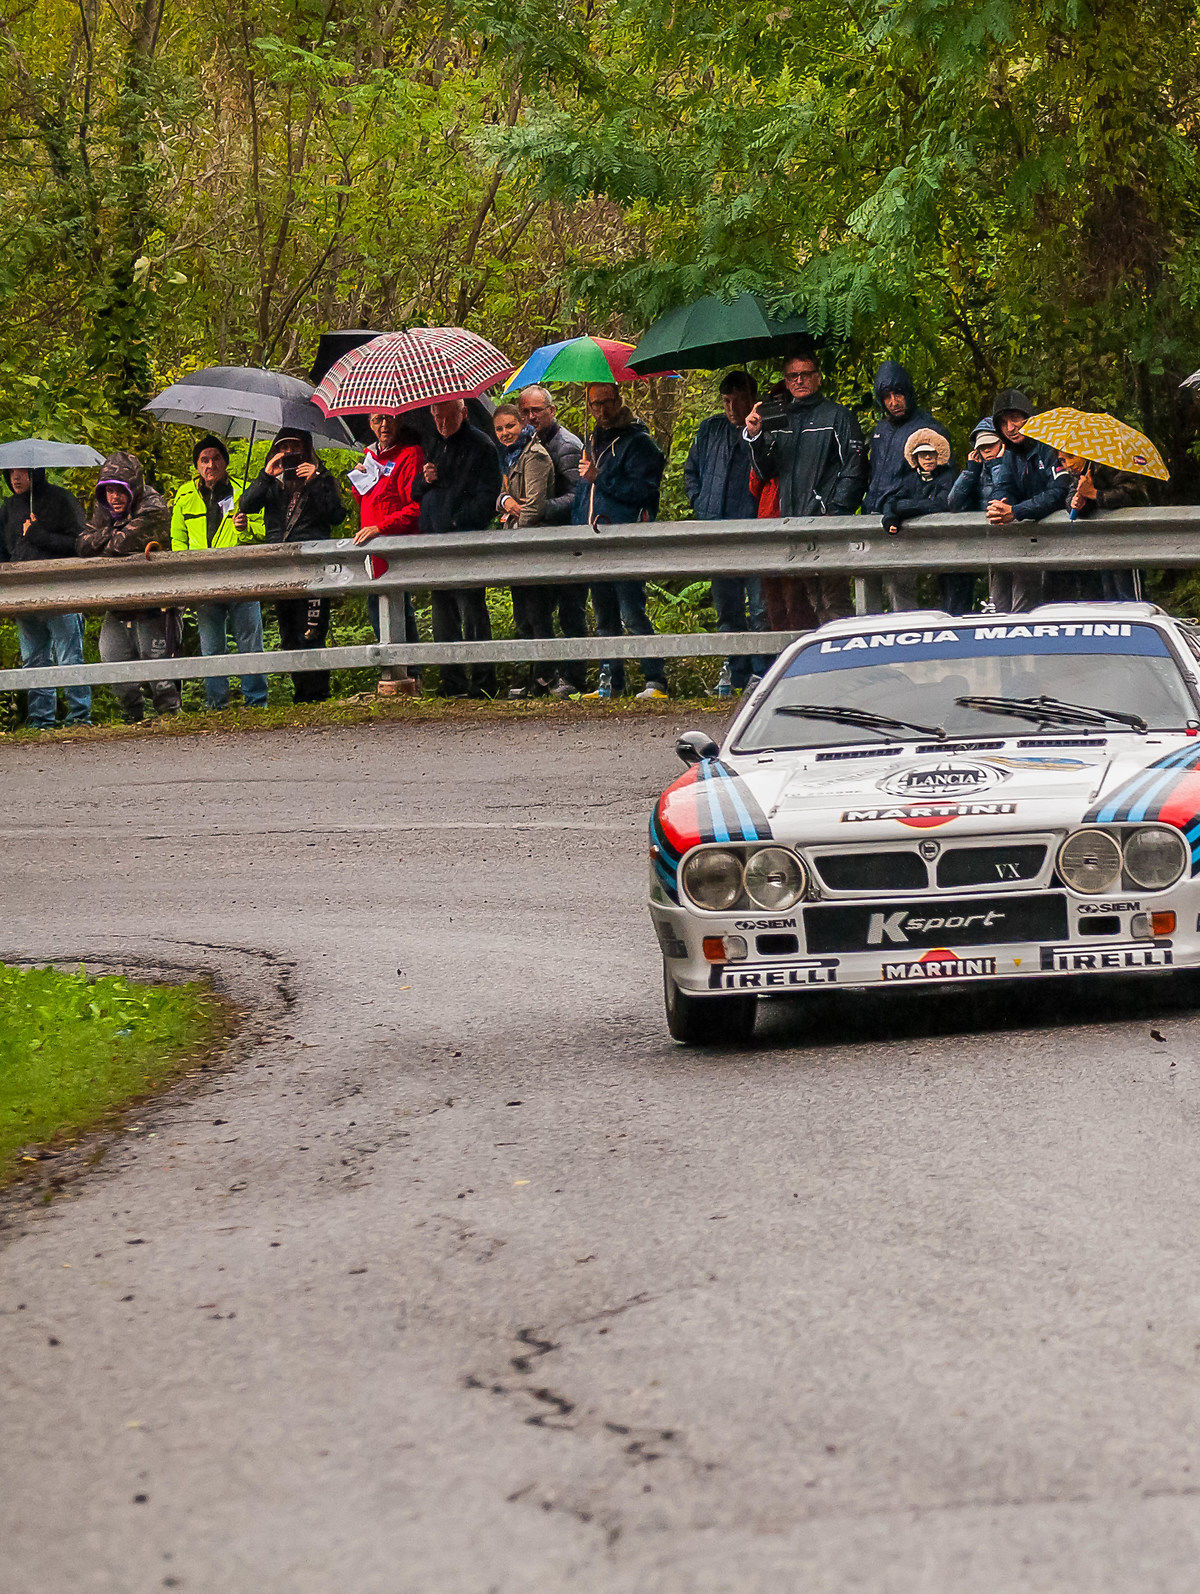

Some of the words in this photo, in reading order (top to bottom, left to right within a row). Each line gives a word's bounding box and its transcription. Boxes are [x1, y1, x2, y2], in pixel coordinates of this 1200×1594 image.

[820, 630, 960, 654] LANCIA
[974, 624, 1132, 640] MARTINI
[910, 773, 979, 787] LANCIA
[847, 803, 1012, 821] MARTINI
[1099, 901, 1141, 912] SIEM
[756, 918, 797, 930] SIEM
[1039, 939, 1173, 970] PIRELLI
[708, 958, 840, 989] PIRELLI
[886, 959, 992, 980] MARTINI
